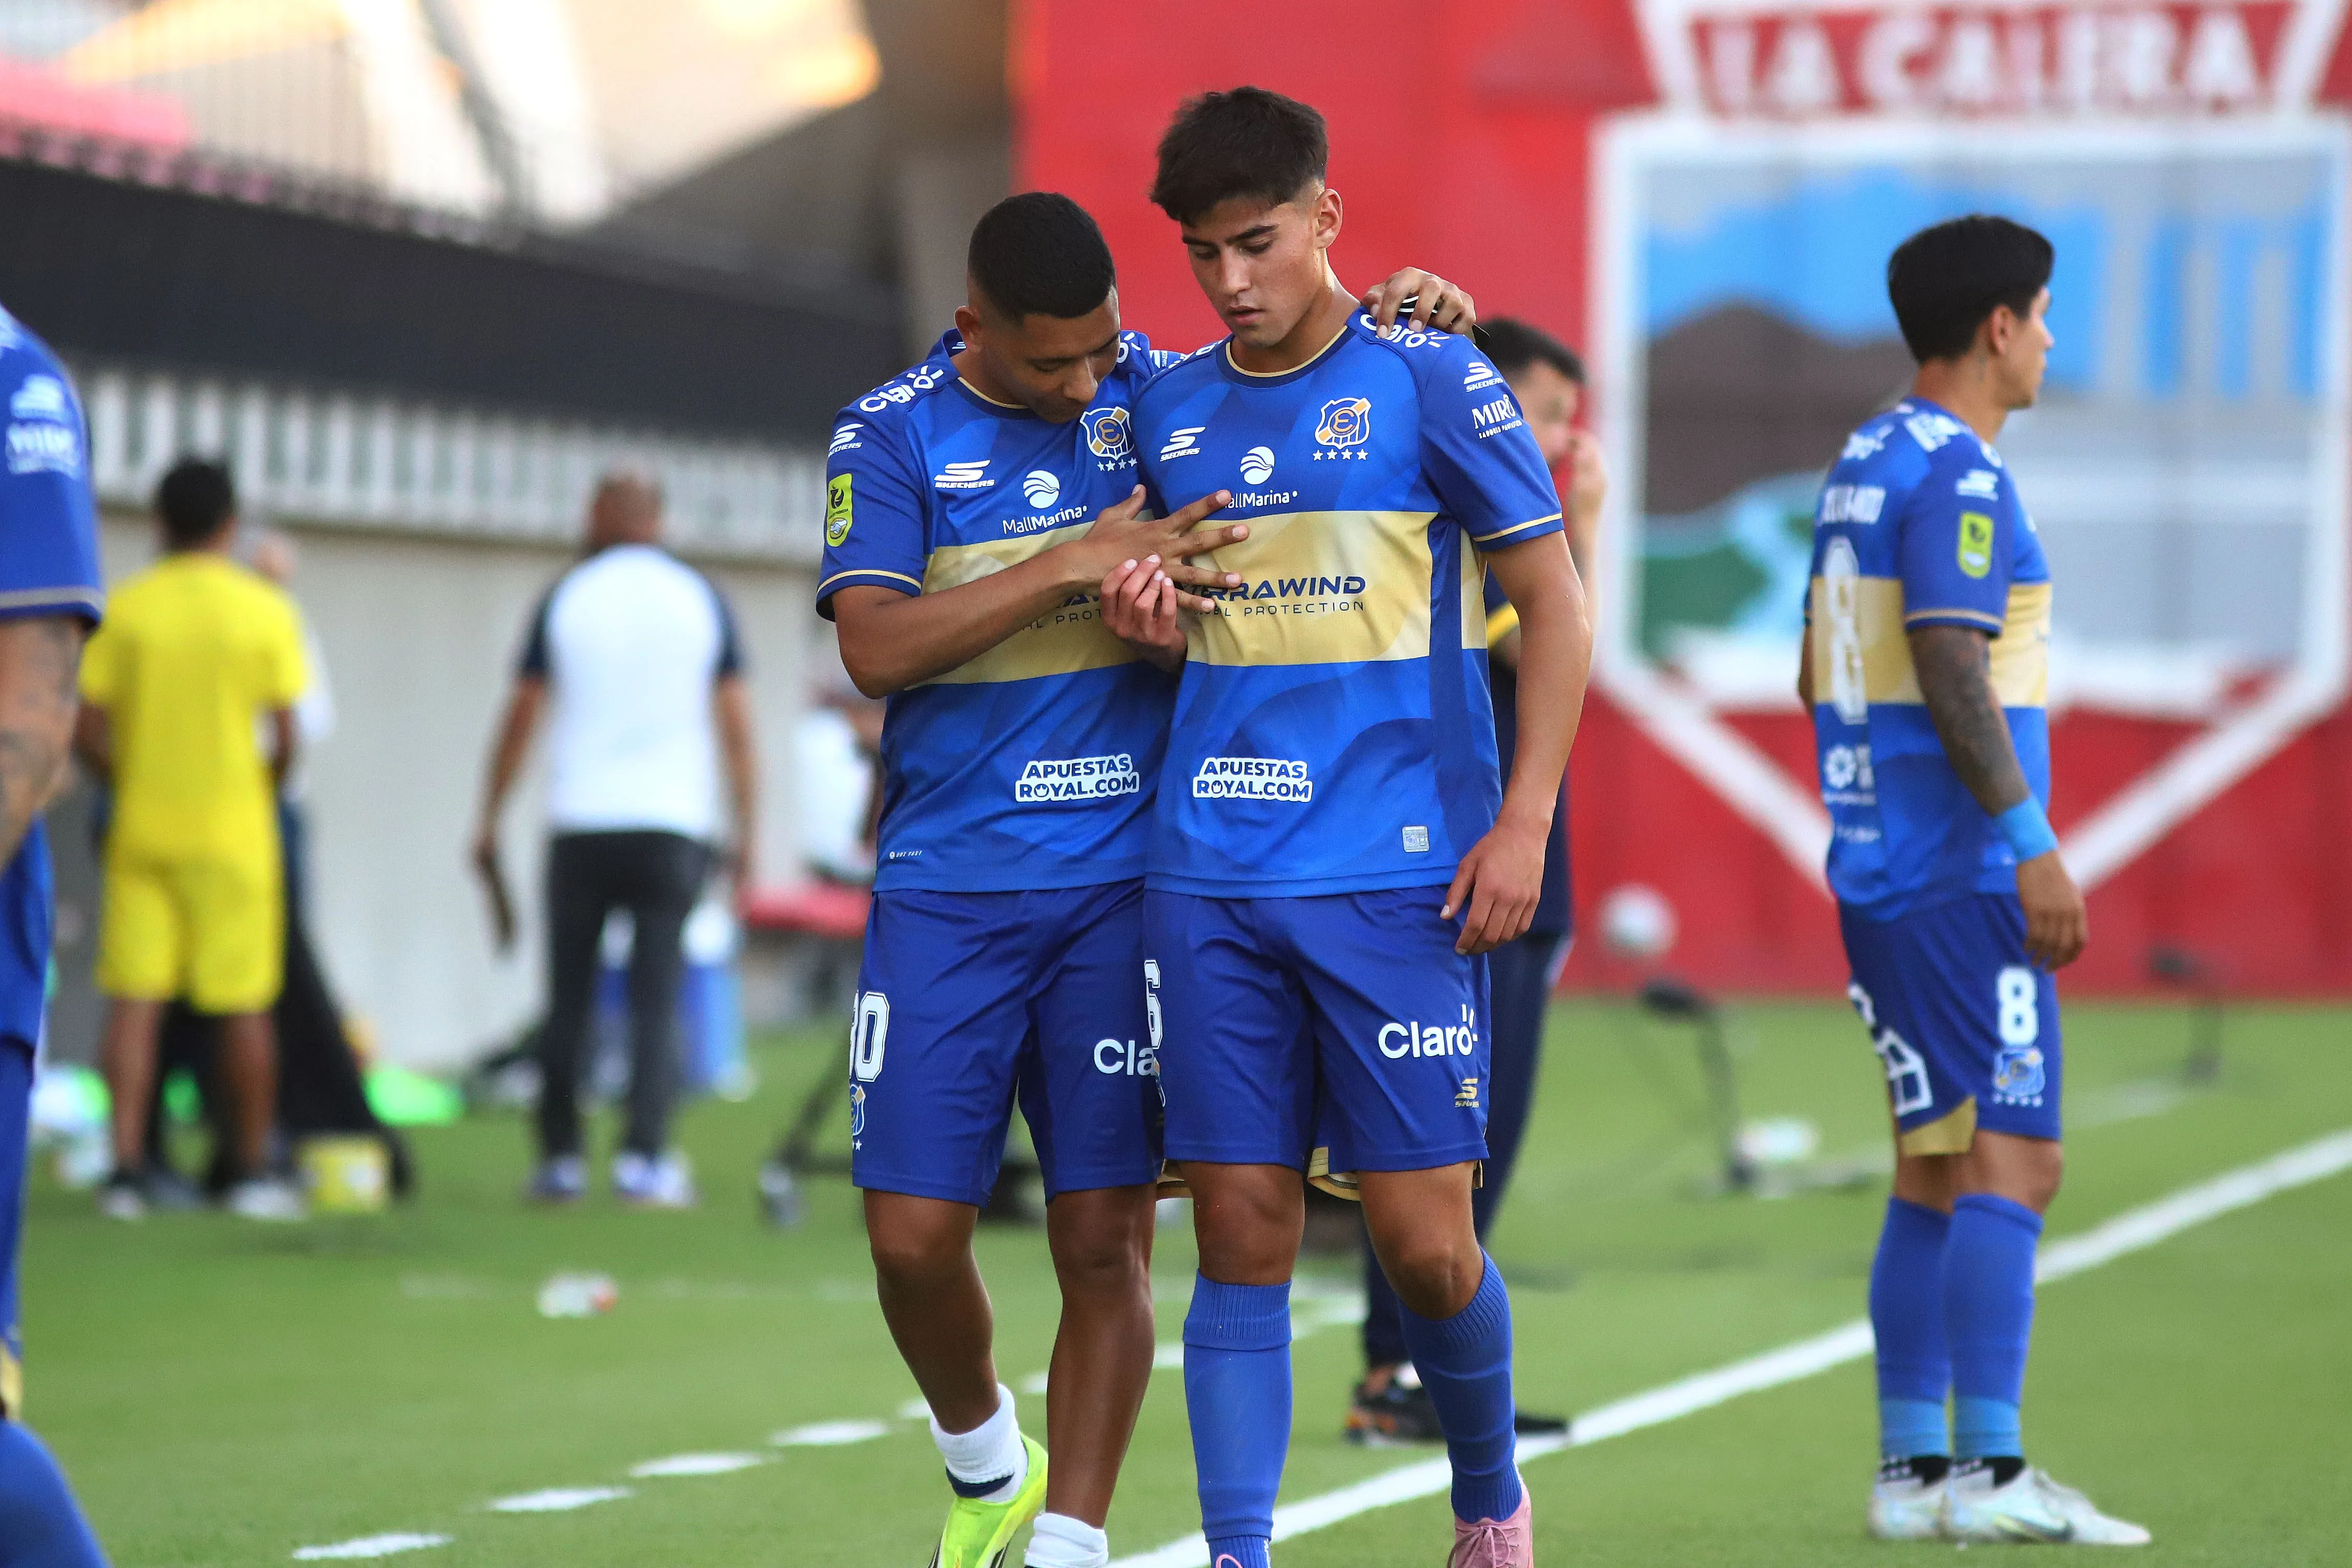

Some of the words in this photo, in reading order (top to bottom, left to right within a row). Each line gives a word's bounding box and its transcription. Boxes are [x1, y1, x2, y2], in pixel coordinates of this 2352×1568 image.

[1360, 314, 1428, 348] Caro
[1160, 448, 1201, 462] SKECHERS
[935, 479, 995, 489] SKECHERS
[1225, 490, 1290, 509] allMarina
[1002, 508, 1082, 534] MallMarina
[1244, 601, 1364, 616] PROTECTION
[1026, 757, 1128, 779] APUESTAS
[1203, 761, 1303, 779] APUESTAS
[1019, 775, 1137, 798] ROYAL.COM
[1197, 780, 1310, 798] ROYAL.COM
[1996, 966, 2039, 1047] 8
[1378, 1021, 1473, 1059] Claro
[1094, 1039, 1154, 1076] Cla
